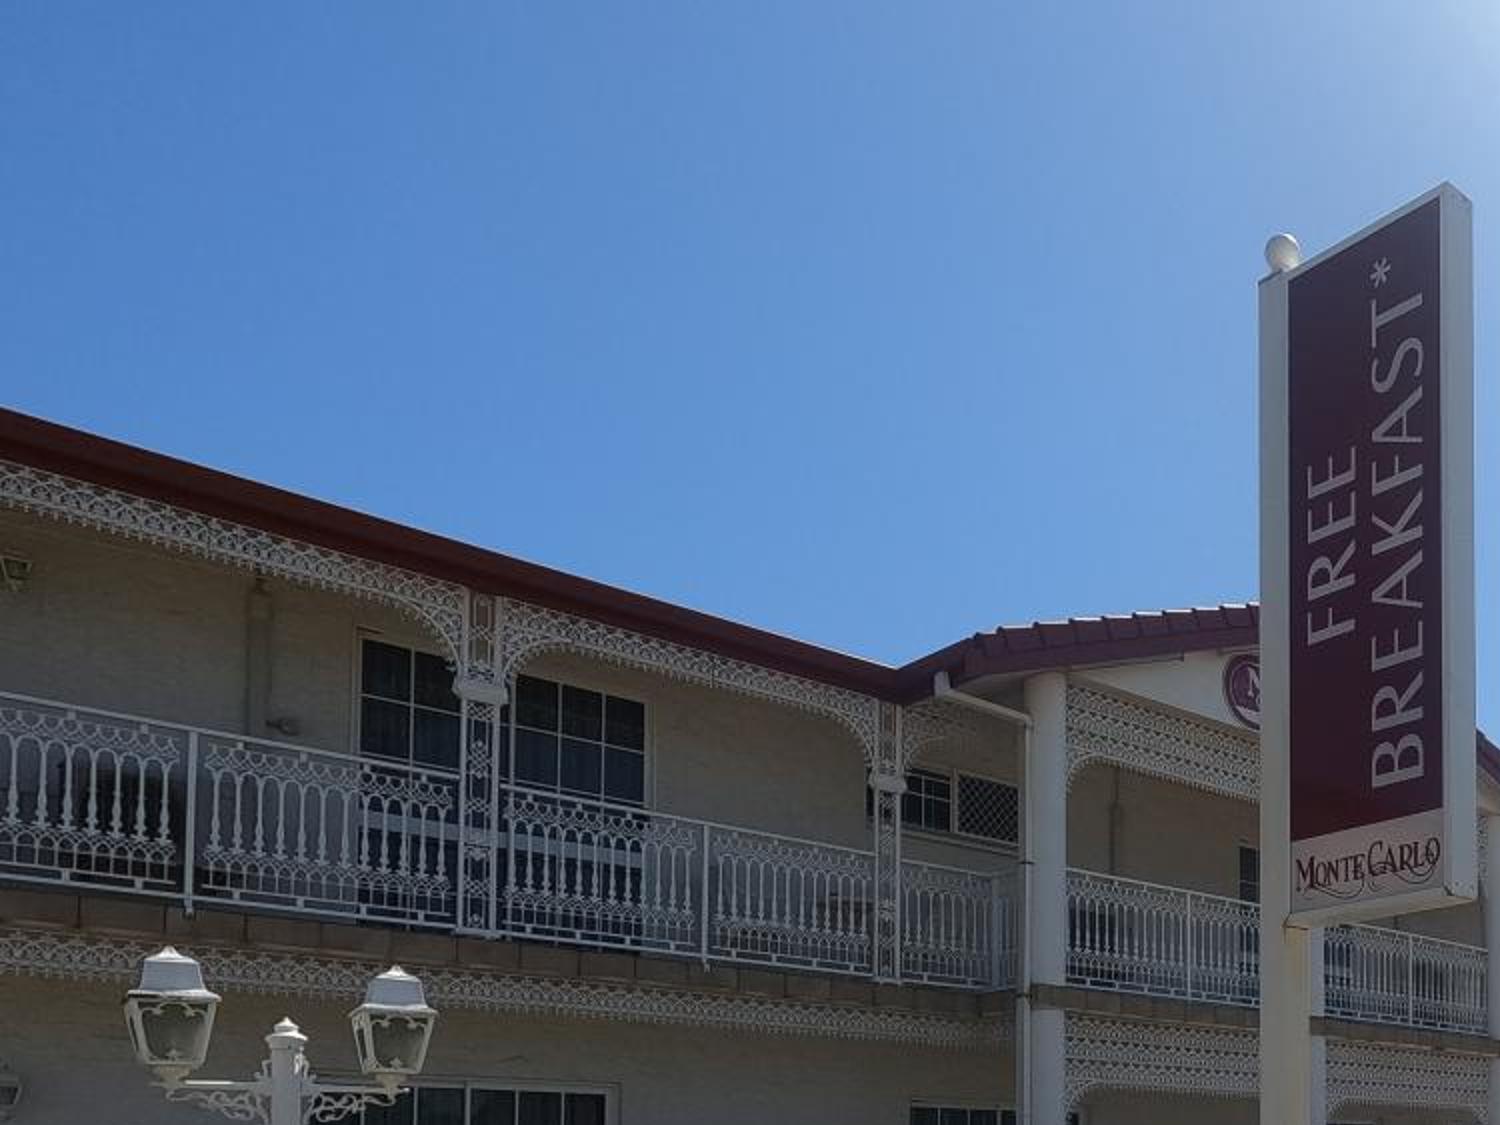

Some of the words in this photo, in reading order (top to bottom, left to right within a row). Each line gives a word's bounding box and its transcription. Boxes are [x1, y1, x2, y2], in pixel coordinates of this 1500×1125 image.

[1306, 446, 1357, 646] FREE
[1295, 853, 1366, 894] MONTE
[1367, 836, 1441, 886] CARLO
